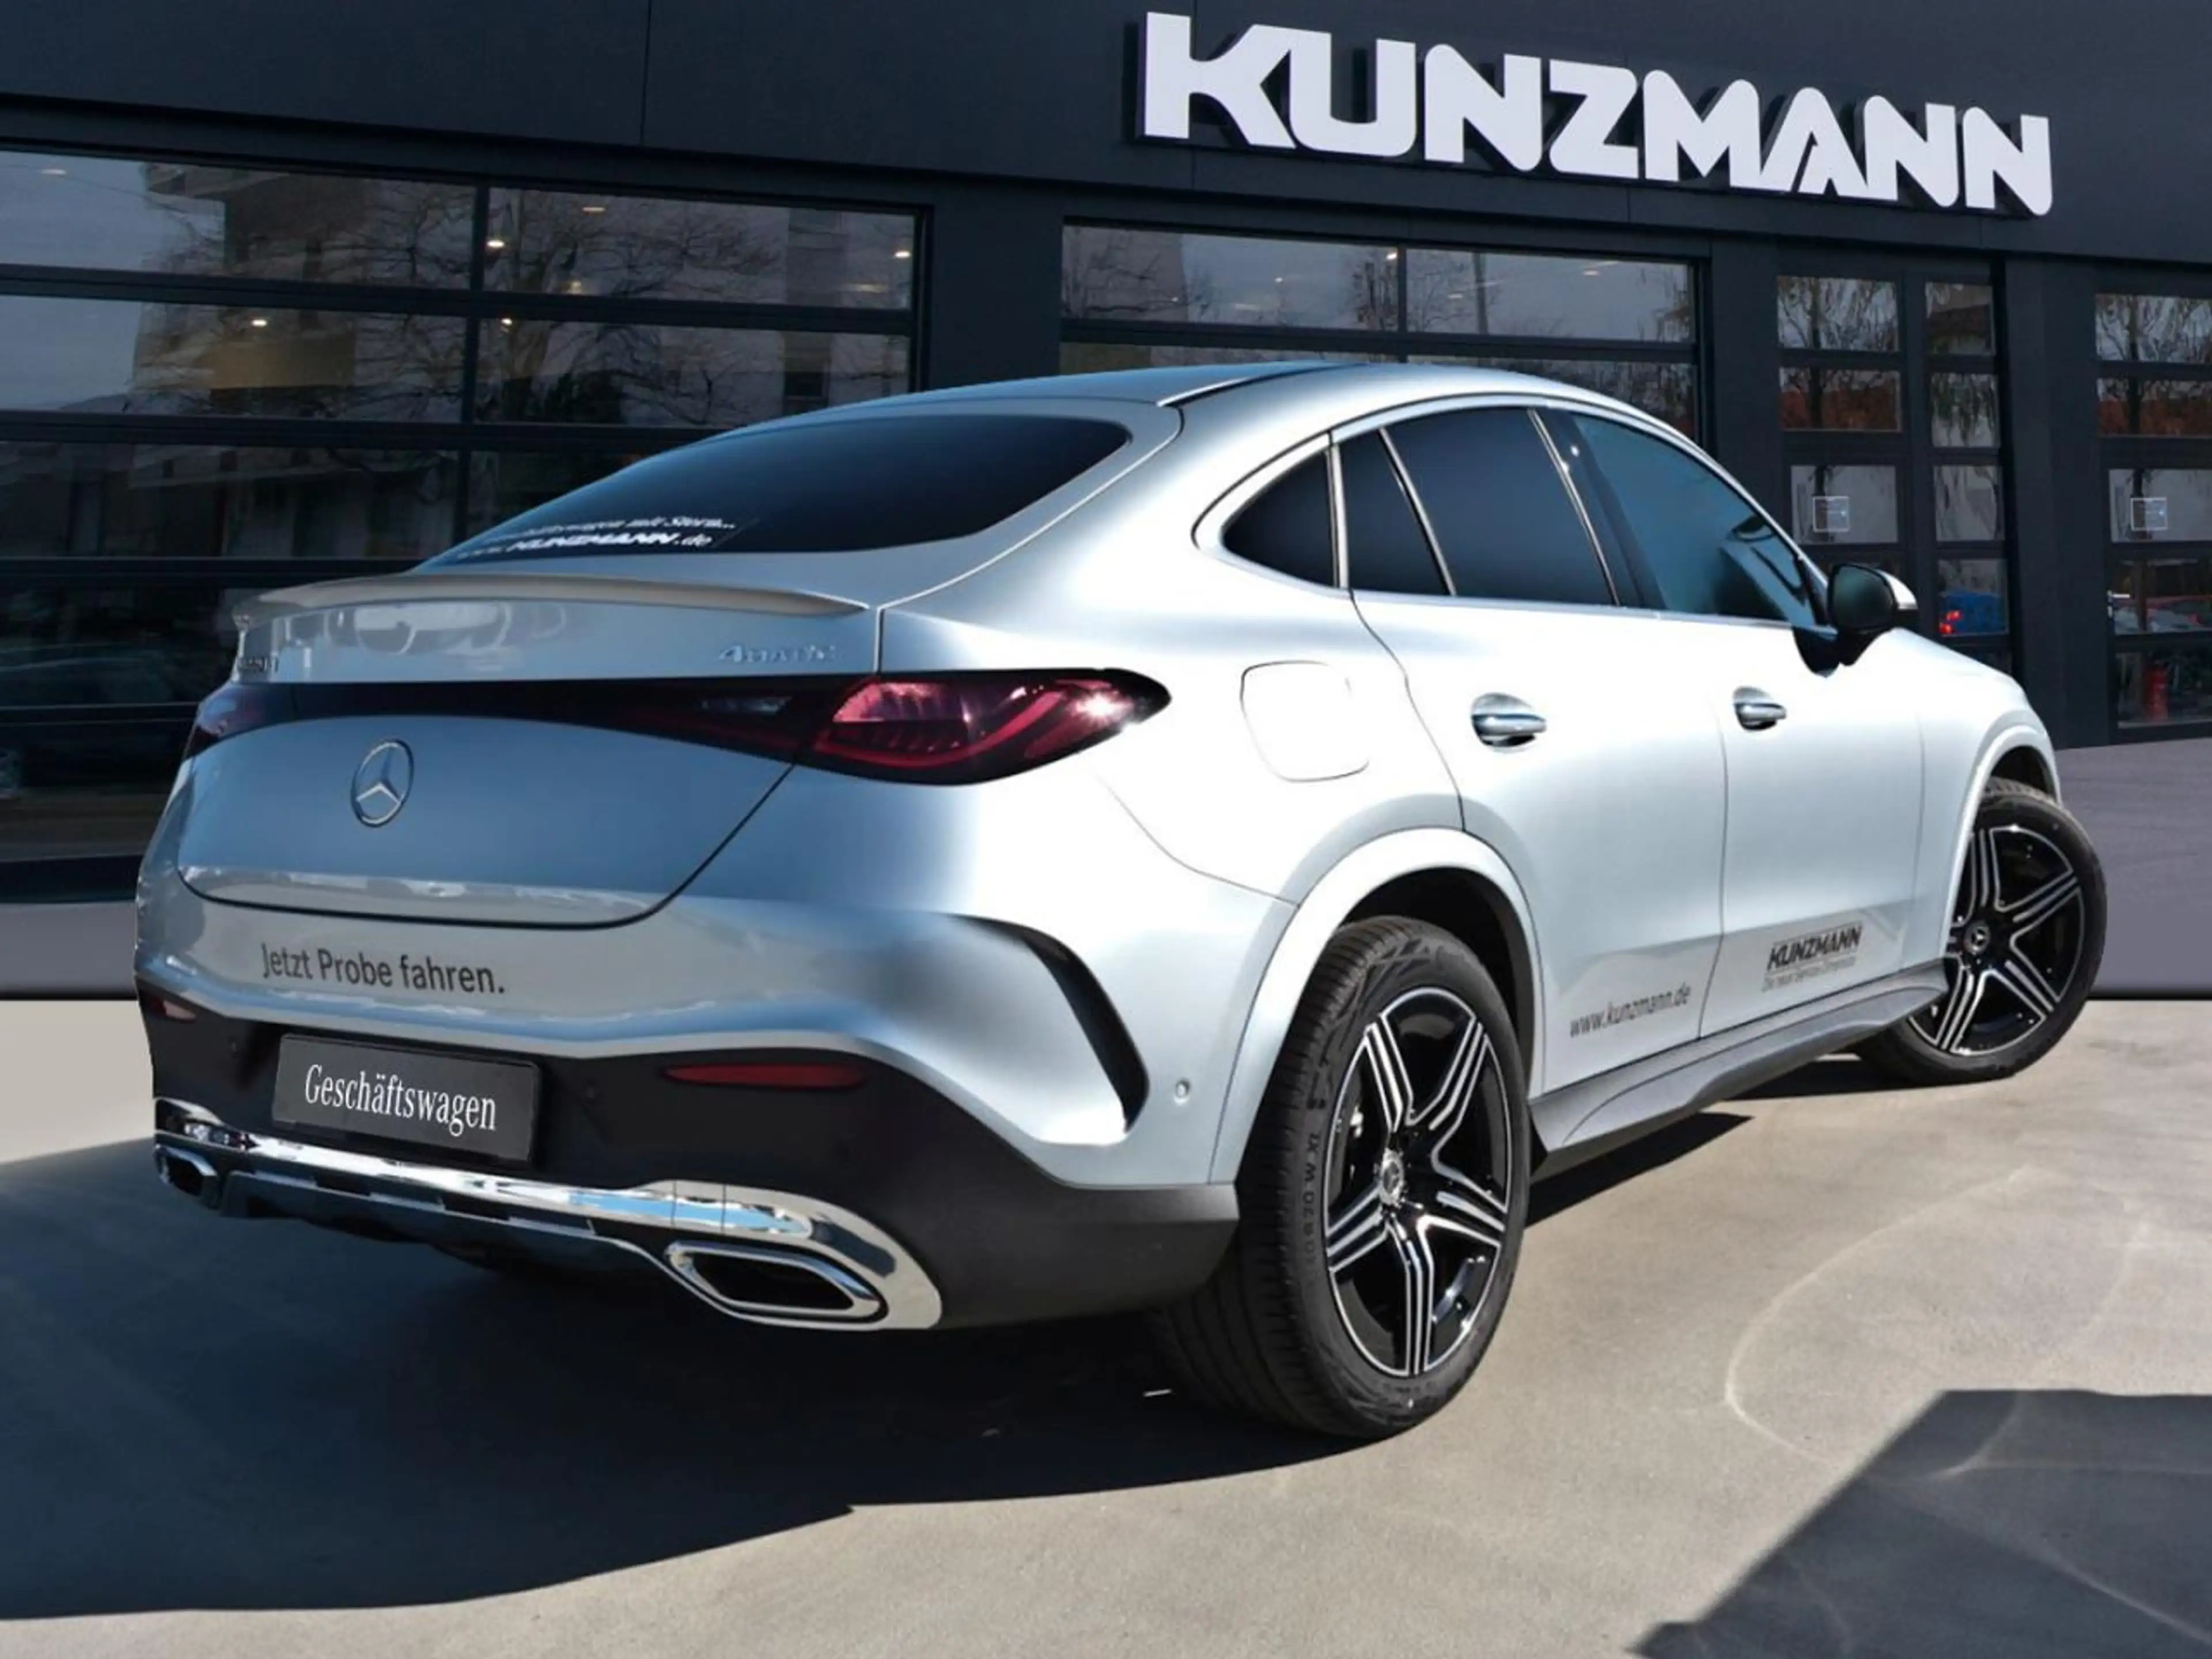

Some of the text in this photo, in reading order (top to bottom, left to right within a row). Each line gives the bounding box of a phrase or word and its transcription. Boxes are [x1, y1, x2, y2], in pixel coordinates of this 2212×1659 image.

[1143, 10, 2052, 216] KUNZMANN
[261, 942, 505, 994] Jetzt Probe fahren.
[1767, 925, 1862, 970] KUNZMANN
[1570, 981, 1691, 1039] www.kunzmann.de
[305, 1064, 497, 1137] Geschäftswagen
